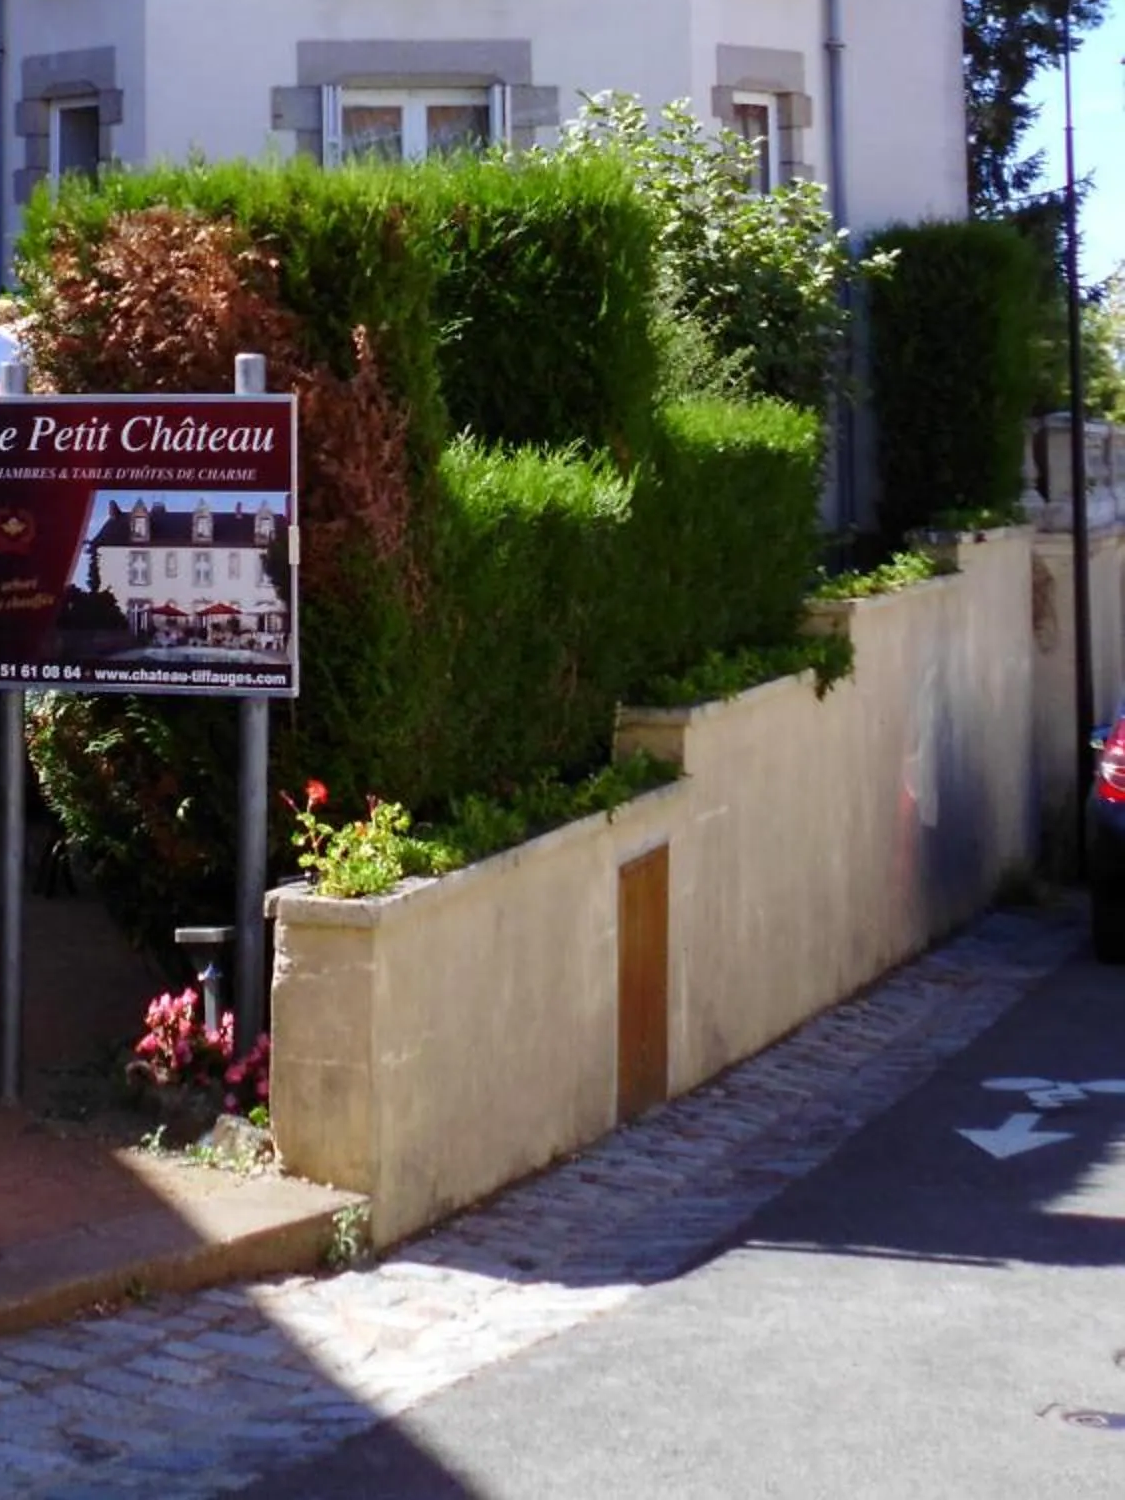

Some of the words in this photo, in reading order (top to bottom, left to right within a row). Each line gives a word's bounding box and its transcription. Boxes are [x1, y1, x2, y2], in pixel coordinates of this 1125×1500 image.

[27, 416, 112, 451] Petit
[120, 415, 275, 452] Château
[72, 467, 113, 480] TABLE
[176, 468, 196, 481] DE
[198, 468, 257, 481] CHARME
[0, 663, 16, 677] 51
[20, 664, 37, 679] 61
[42, 665, 60, 679] 08
[63, 665, 81, 679] 64
[94, 667, 286, 687] www.chateau-tiffauges.com
